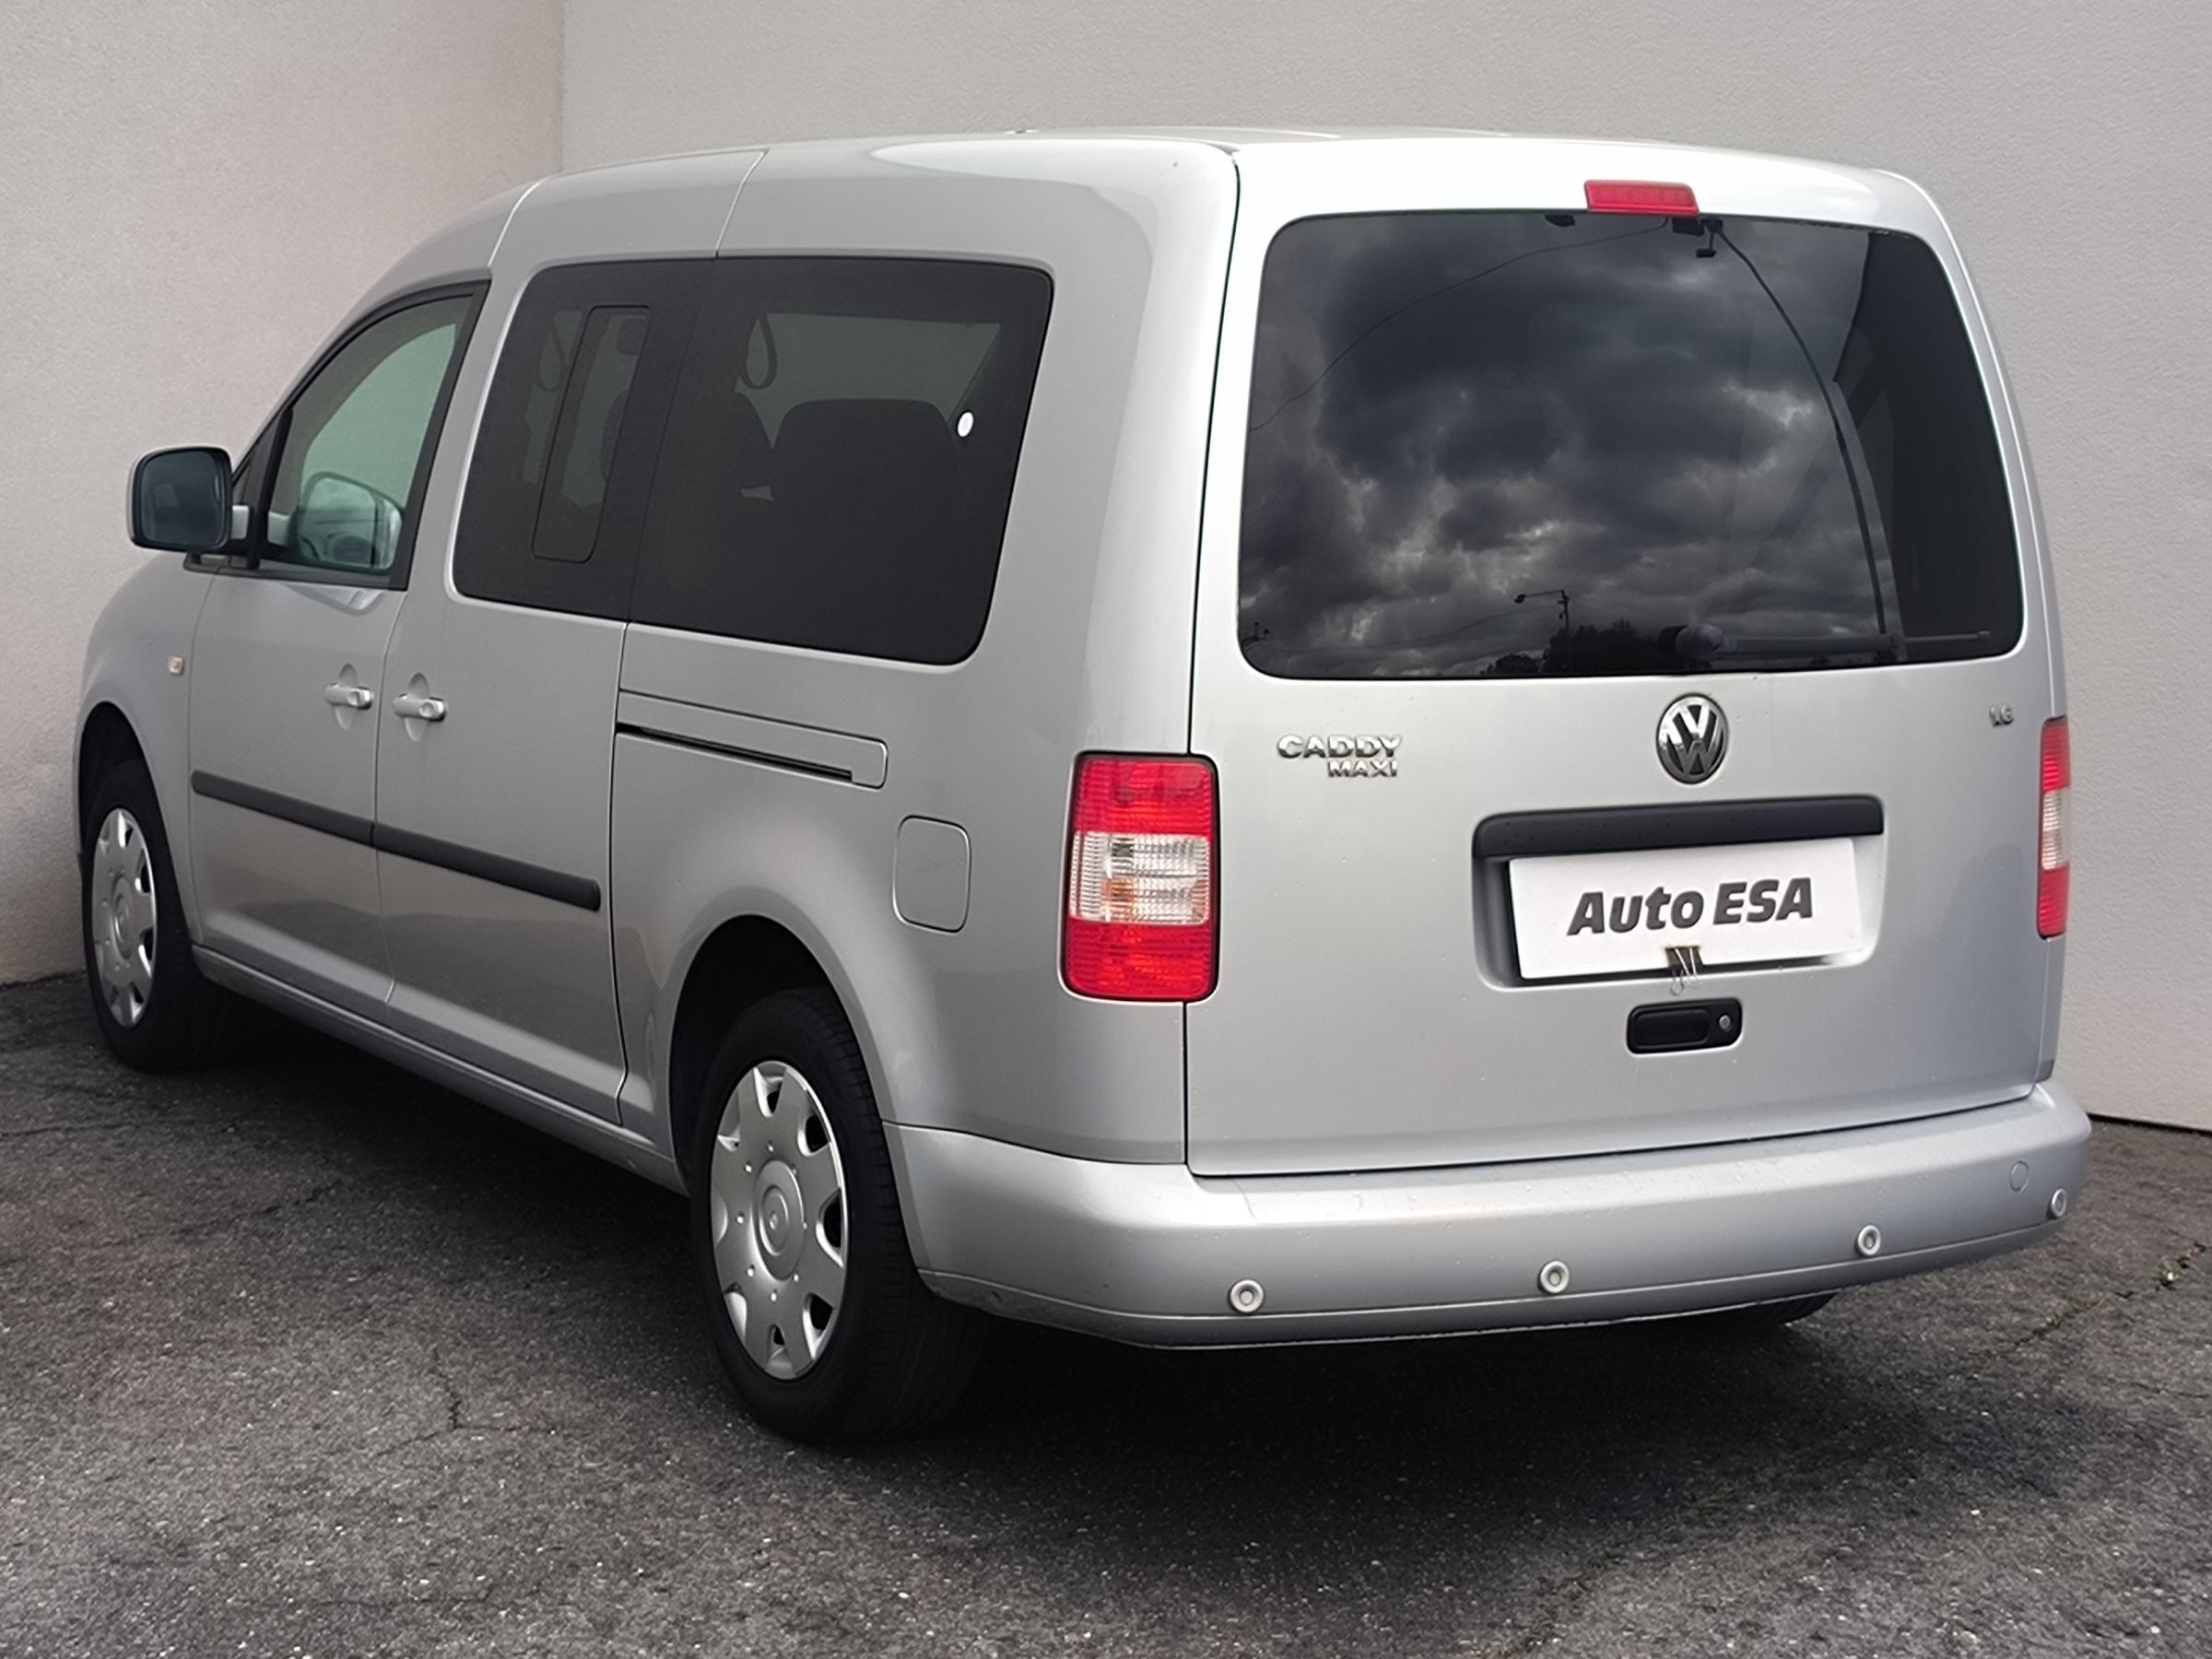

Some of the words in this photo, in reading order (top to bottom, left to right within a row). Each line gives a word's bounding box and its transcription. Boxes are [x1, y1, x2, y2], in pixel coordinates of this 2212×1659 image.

[1277, 734, 1402, 759] CADDY
[1327, 759, 1398, 778] MAXI
[1567, 886, 1705, 936] Auto
[1712, 877, 1813, 925] ESA
